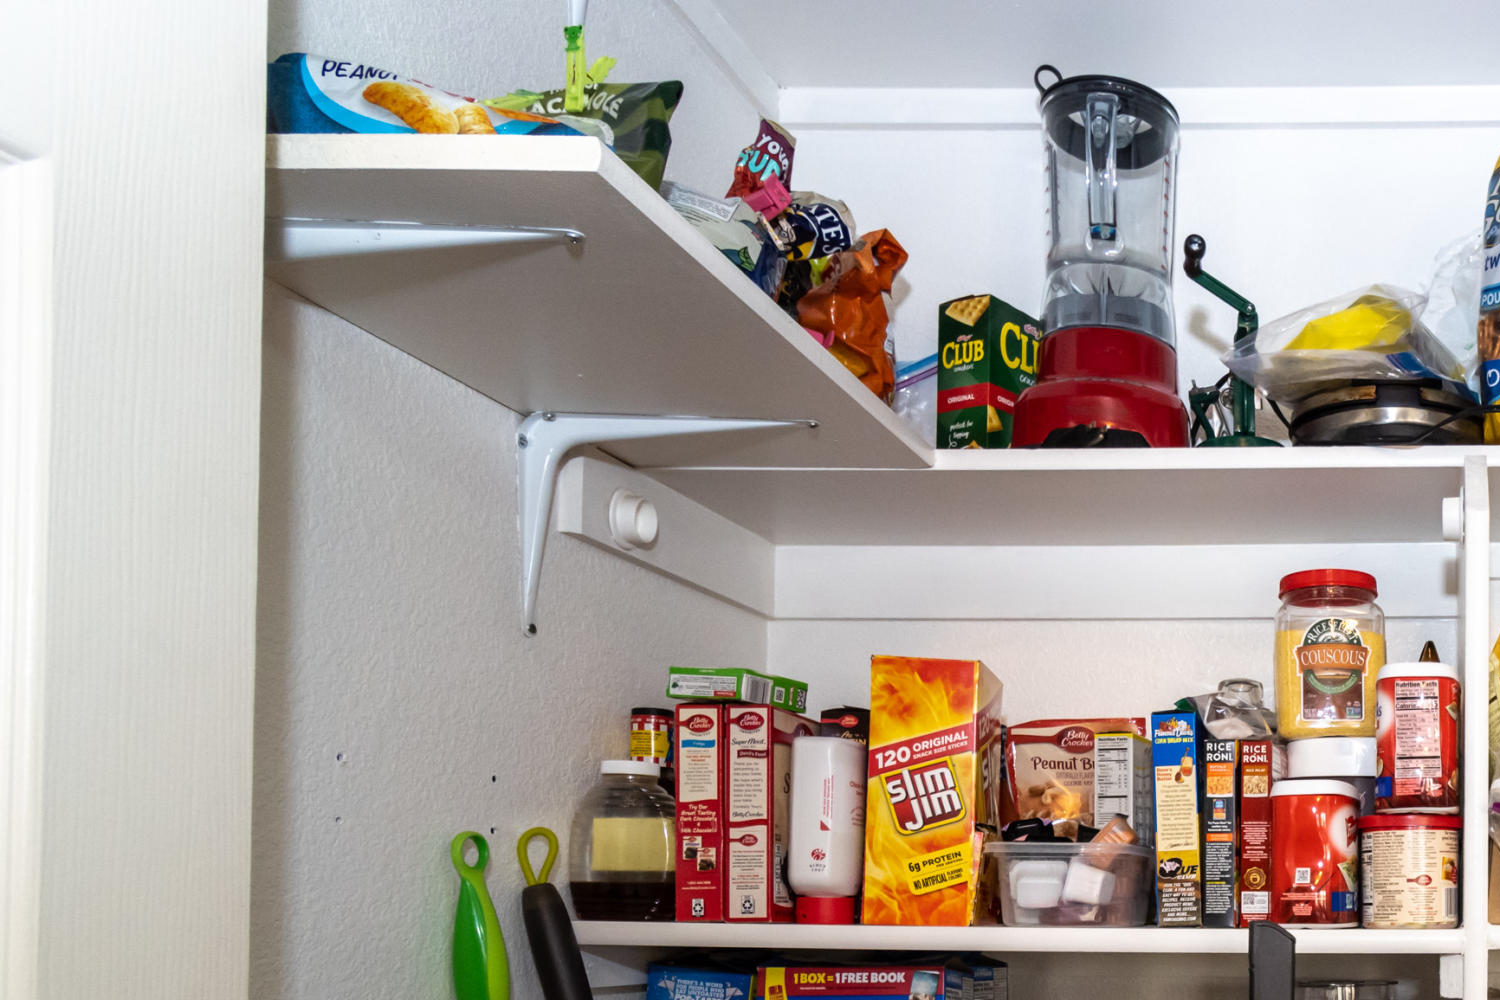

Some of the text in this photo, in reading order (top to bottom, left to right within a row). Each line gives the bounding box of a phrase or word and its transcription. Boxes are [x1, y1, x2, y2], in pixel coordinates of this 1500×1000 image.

[942, 339, 984, 369] CLUB
[1307, 621, 1327, 641] RICE
[1301, 649, 1366, 666] COUSCOUS
[1061, 738, 1093, 748] Crocker
[1066, 730, 1088, 742] Betty
[875, 731, 968, 769] 120 ORIGINAL
[912, 741, 969, 760] SNACK SIZE STICKS
[1206, 742, 1231, 751] RICE
[1243, 745, 1267, 753] RICE
[1031, 756, 1077, 771] Peanut
[908, 851, 962, 873] 6g PROTEIN
[914, 873, 948, 890] NO ARTIFICIAL
[800, 973, 826, 984] BOX
[841, 973, 869, 983] FREE
[871, 972, 905, 983] BOOK
